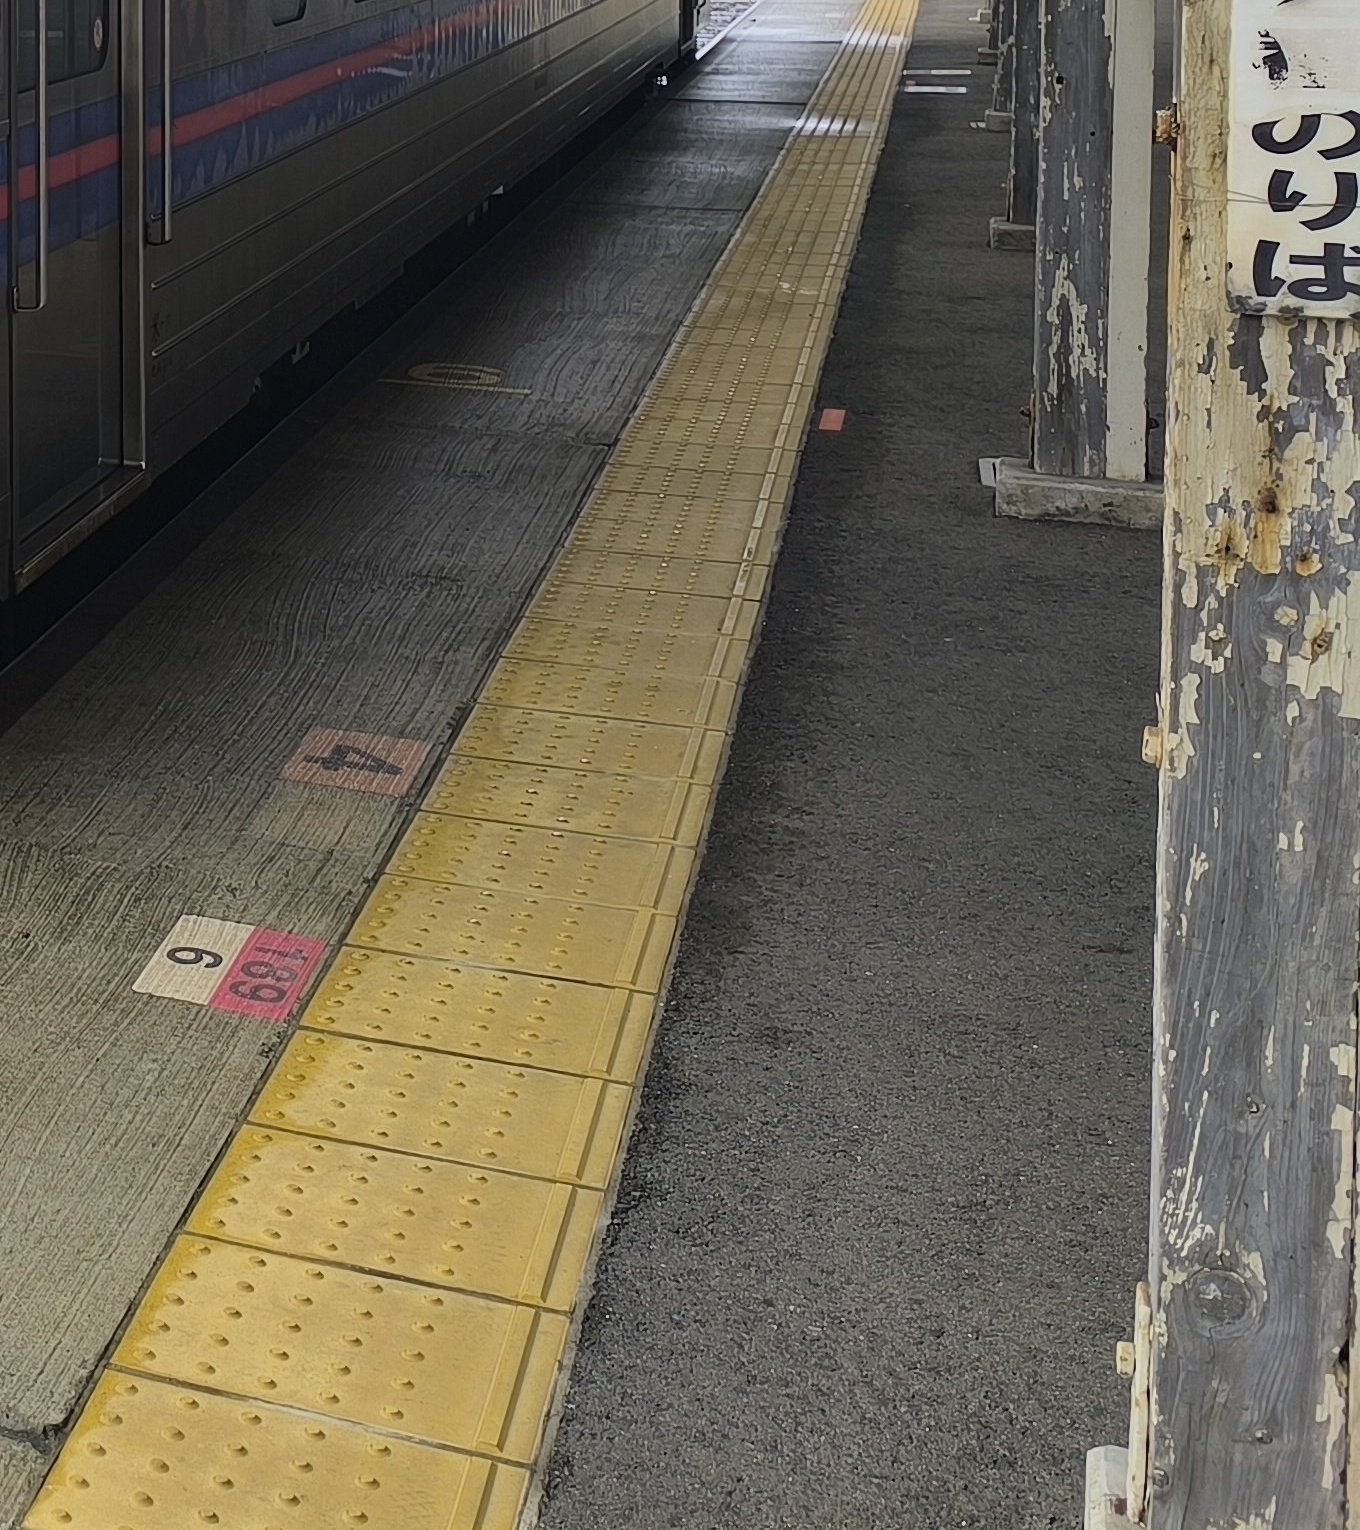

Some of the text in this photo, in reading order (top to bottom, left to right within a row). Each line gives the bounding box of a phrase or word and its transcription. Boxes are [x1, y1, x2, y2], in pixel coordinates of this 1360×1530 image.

[303, 744, 403, 776] 4
[166, 946, 224, 969] 6
[229, 944, 310, 1003] 189
